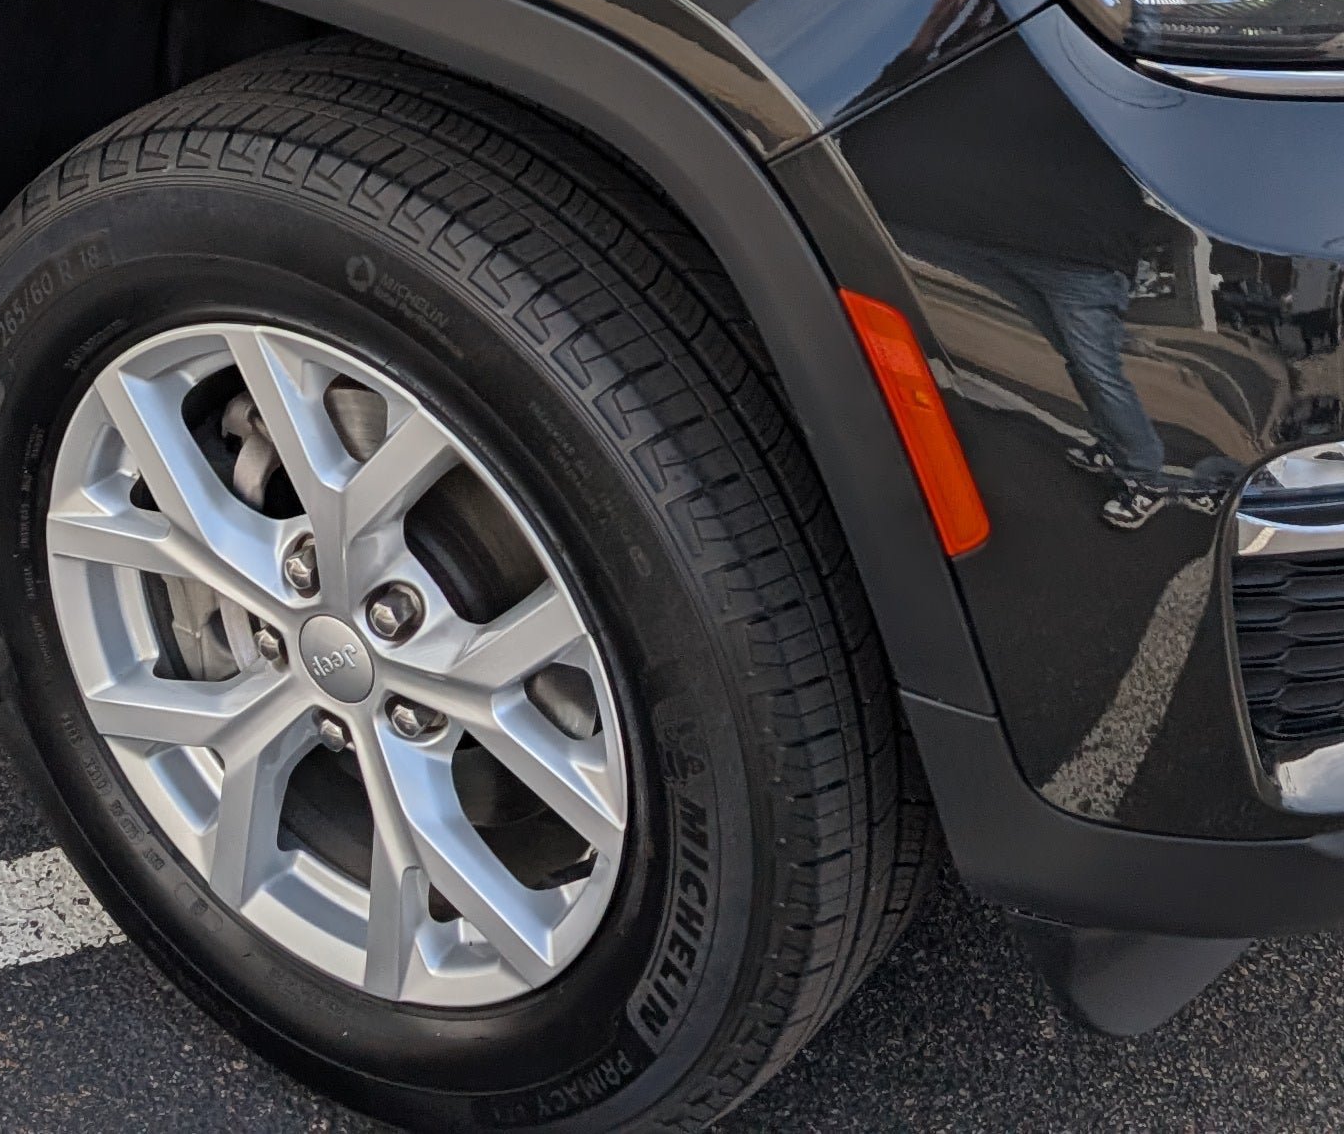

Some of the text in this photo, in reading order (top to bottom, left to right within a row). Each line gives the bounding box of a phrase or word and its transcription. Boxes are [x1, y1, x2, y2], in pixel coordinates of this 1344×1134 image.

[311, 643, 357, 677] Jeep
[637, 792, 710, 1038] MICHELIN
[537, 1049, 633, 1117] PRIMACY
